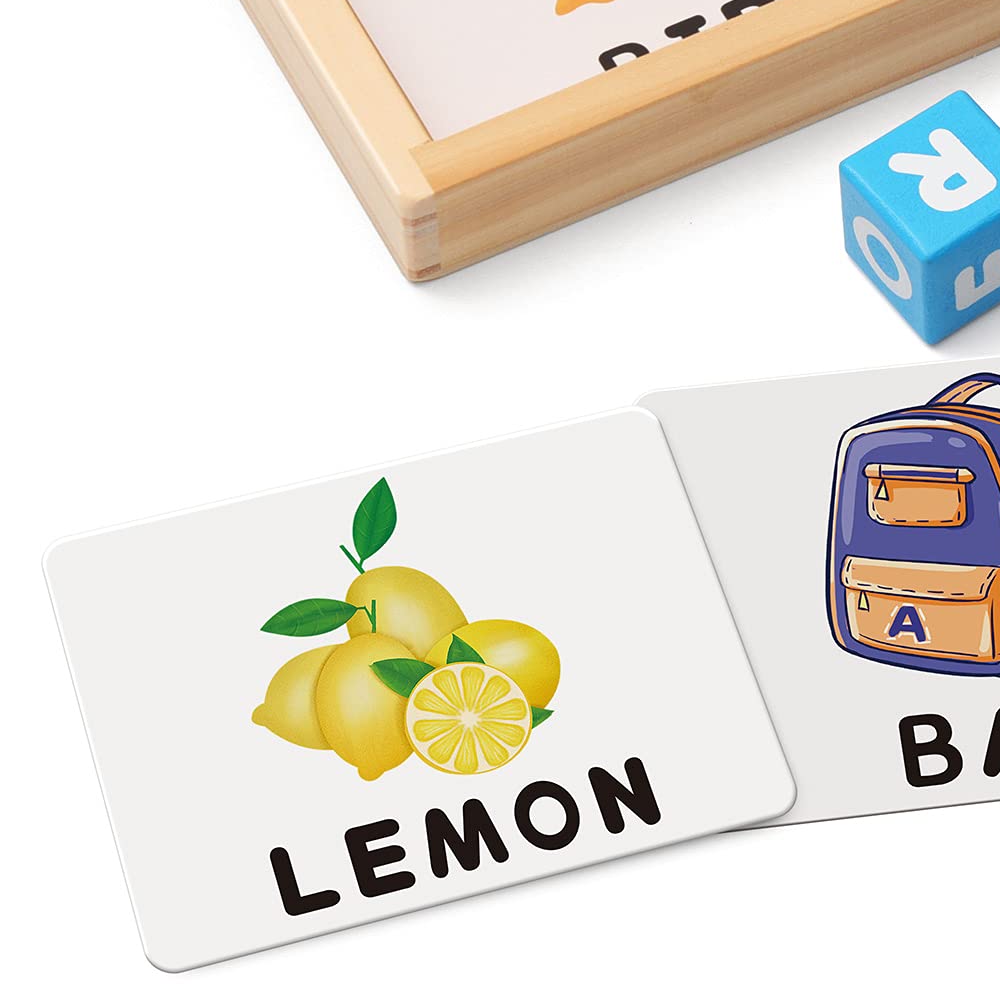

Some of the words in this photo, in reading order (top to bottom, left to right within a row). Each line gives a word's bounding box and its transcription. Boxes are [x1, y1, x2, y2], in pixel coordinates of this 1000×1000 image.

[888, 128, 998, 212] R
[852, 215, 913, 300] O
[885, 603, 931, 644] A
[269, 757, 662, 917] LEMON
